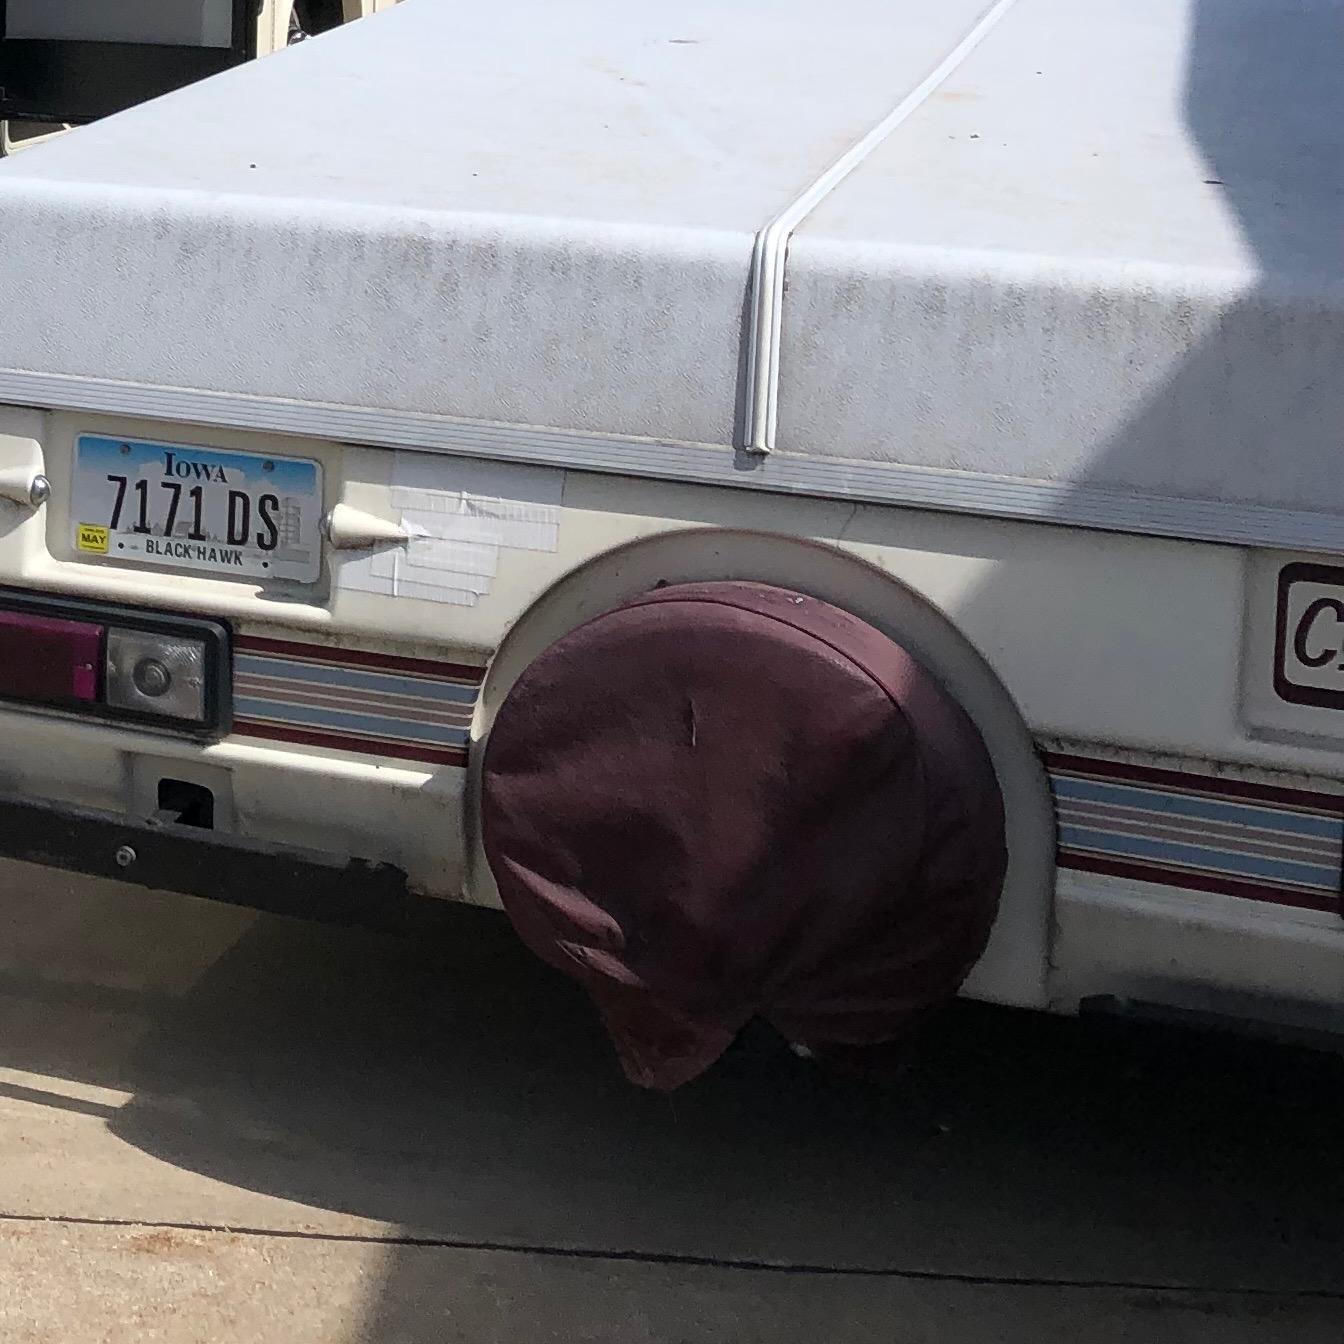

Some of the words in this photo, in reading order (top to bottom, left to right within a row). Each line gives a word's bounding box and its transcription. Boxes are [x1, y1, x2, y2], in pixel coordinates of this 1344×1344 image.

[107, 474, 207, 542] 7171
[226, 489, 279, 551] DS
[81, 533, 106, 544] MAY
[145, 539, 193, 560] BLACK
[196, 544, 244, 567] HAWK
